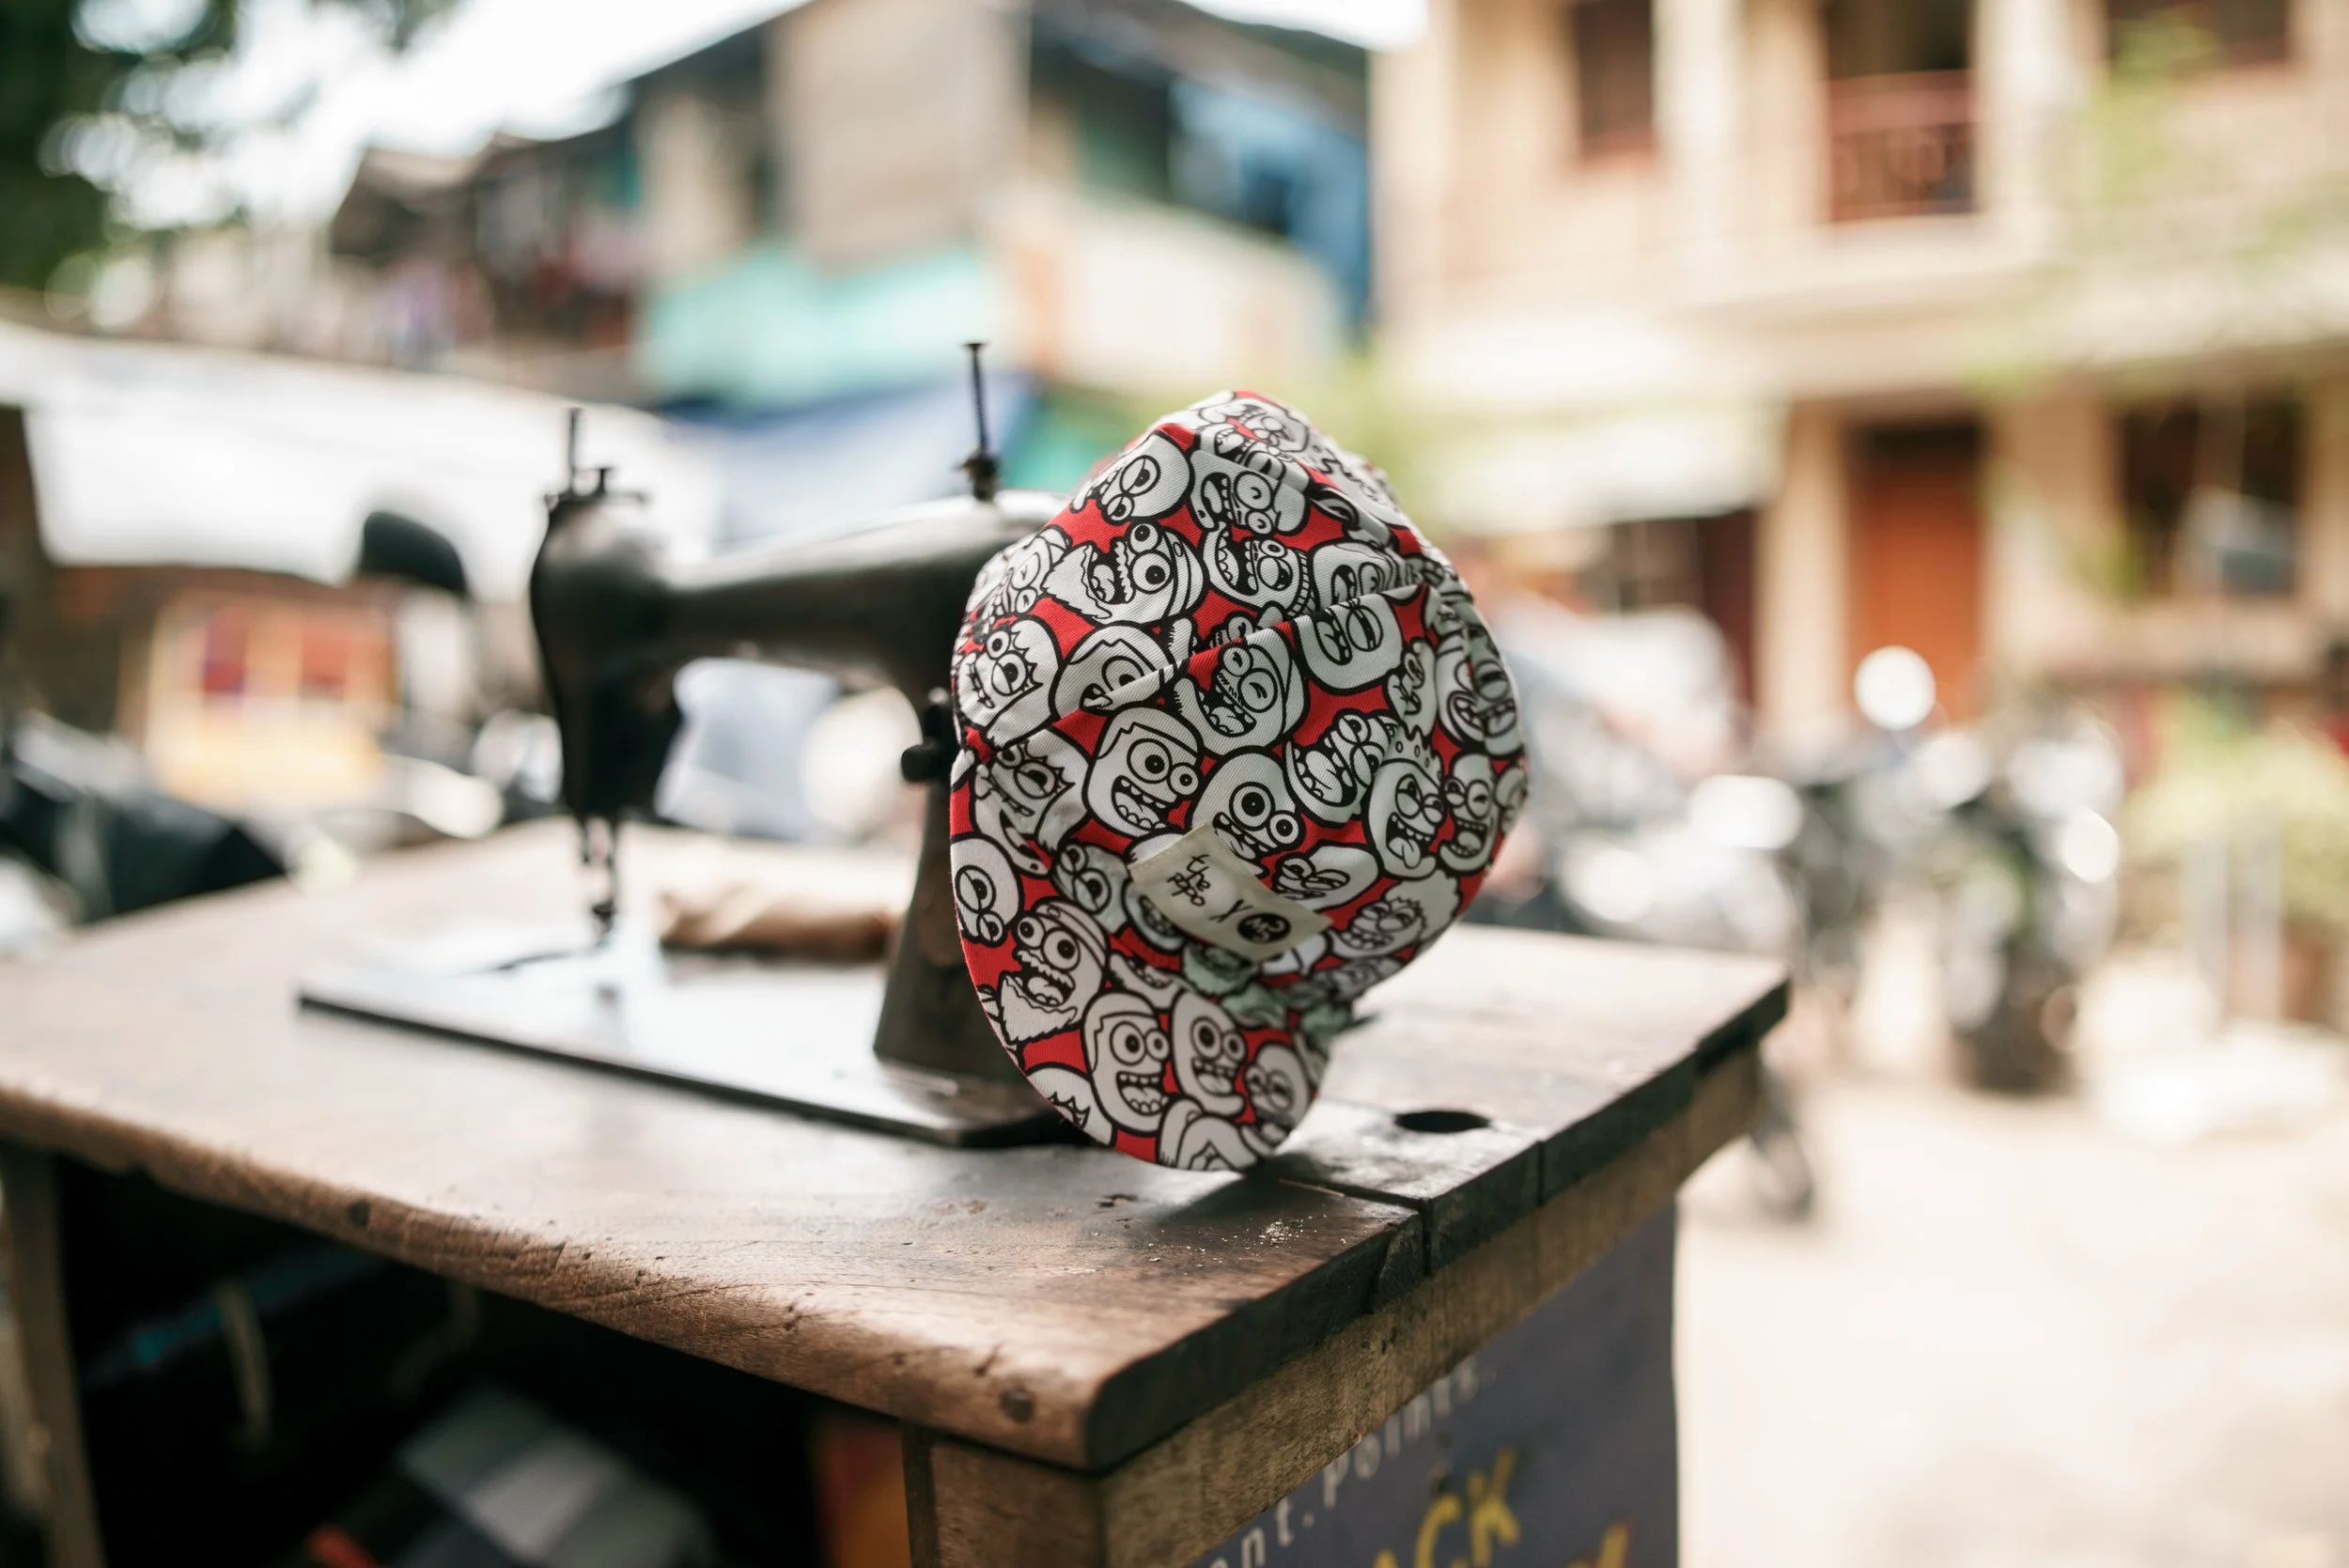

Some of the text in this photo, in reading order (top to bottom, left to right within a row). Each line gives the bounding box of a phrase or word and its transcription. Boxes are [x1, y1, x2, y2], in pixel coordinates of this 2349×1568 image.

[1186, 853, 1211, 893] the
[1209, 1496, 1315, 1568] nt.
[1374, 1450, 1519, 1568] CK
